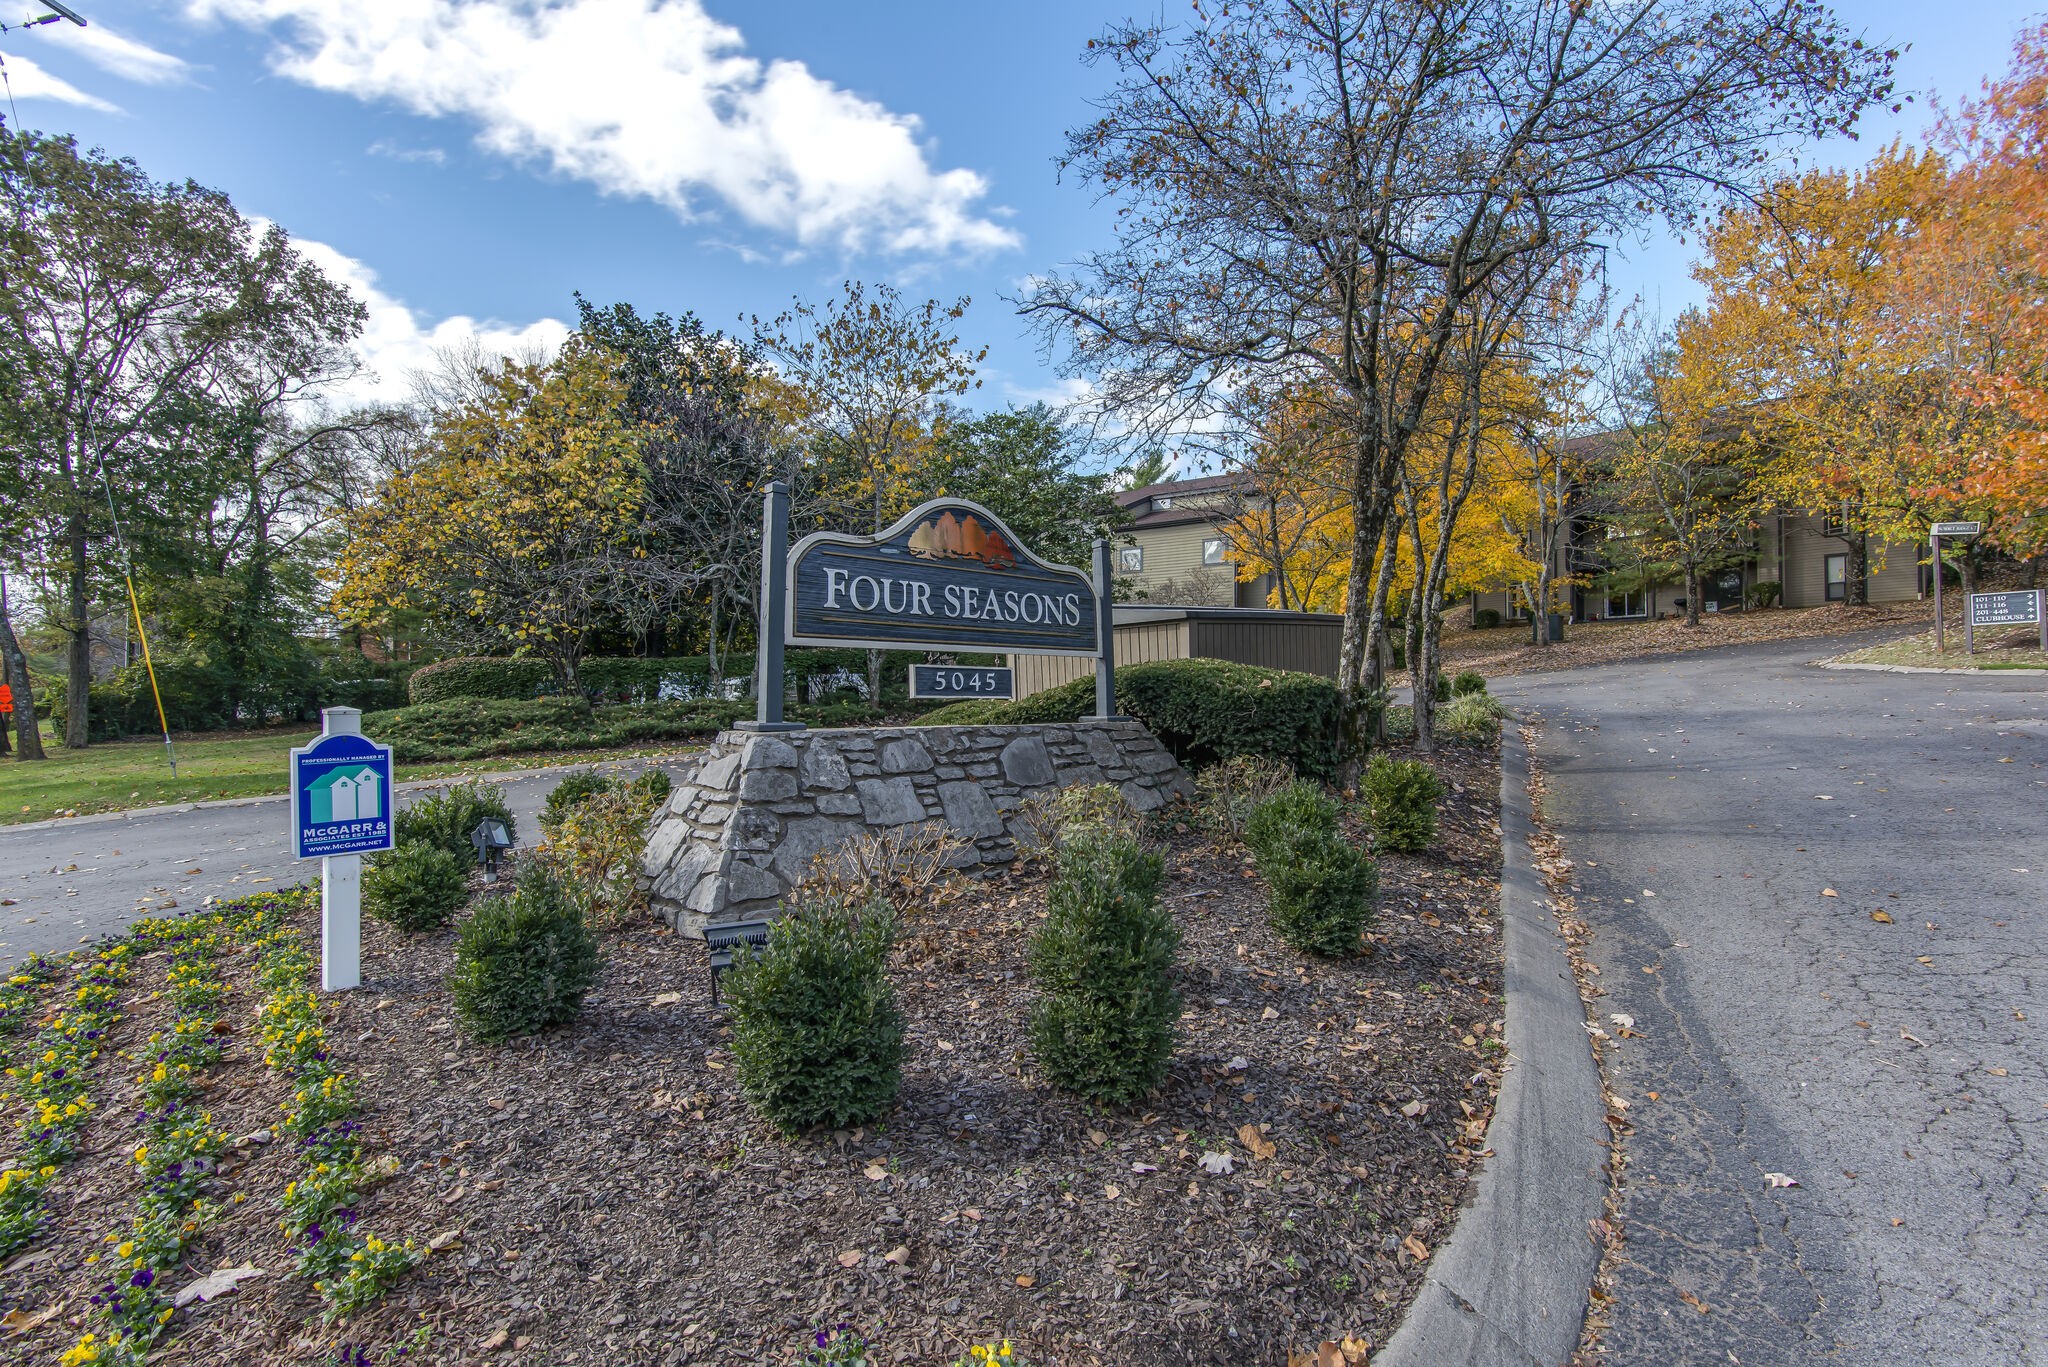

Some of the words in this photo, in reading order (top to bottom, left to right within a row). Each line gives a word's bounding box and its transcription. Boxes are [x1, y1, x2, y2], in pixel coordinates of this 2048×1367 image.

[822, 567, 935, 616] FOUR
[943, 584, 1081, 627] SEASONS
[1976, 614, 2026, 622] CLUBHOUSE
[934, 671, 997, 692] 5045
[375, 821, 387, 830] &
[303, 833, 350, 843] ASSOCIATES
